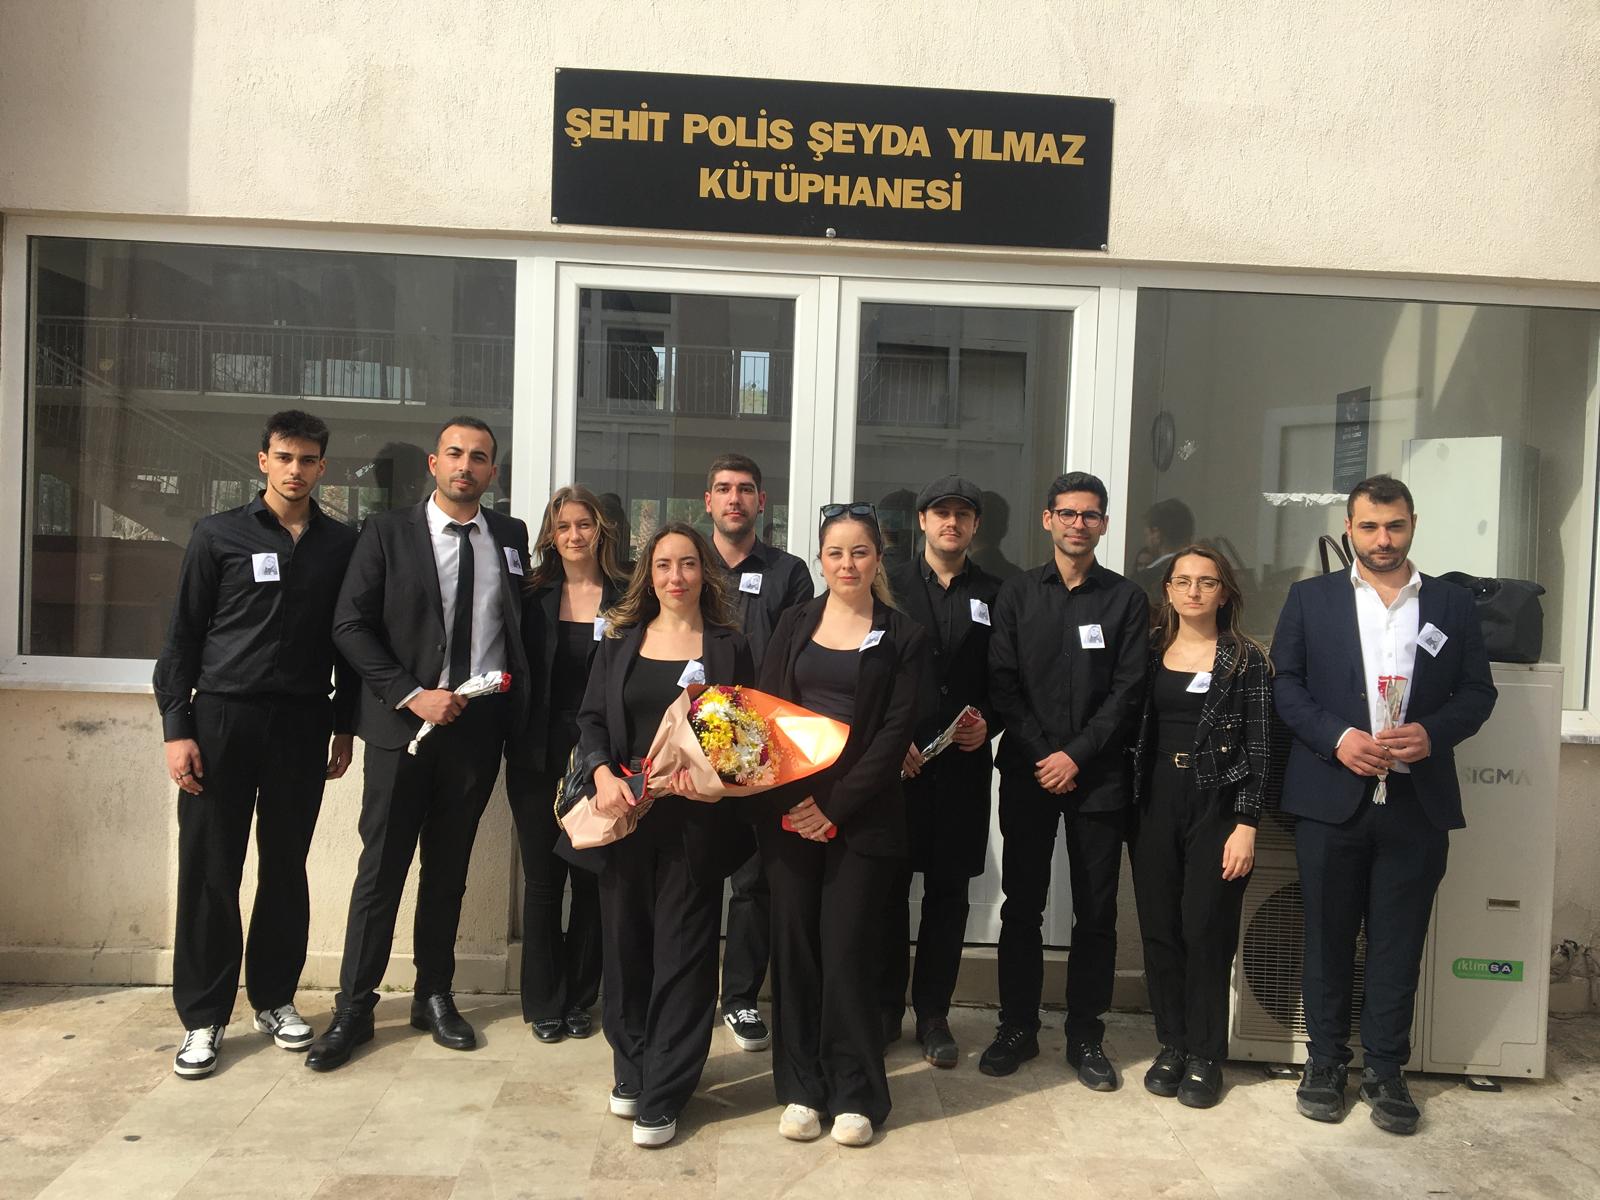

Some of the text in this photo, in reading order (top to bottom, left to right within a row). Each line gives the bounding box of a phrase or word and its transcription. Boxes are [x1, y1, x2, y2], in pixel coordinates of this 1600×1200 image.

[564, 102, 1086, 165] ŞEHİT POLİS ŞEYDA YILMAZ
[699, 161, 962, 211] KÜTÜPHANESİ
[1463, 767, 1532, 786] SIGMA
